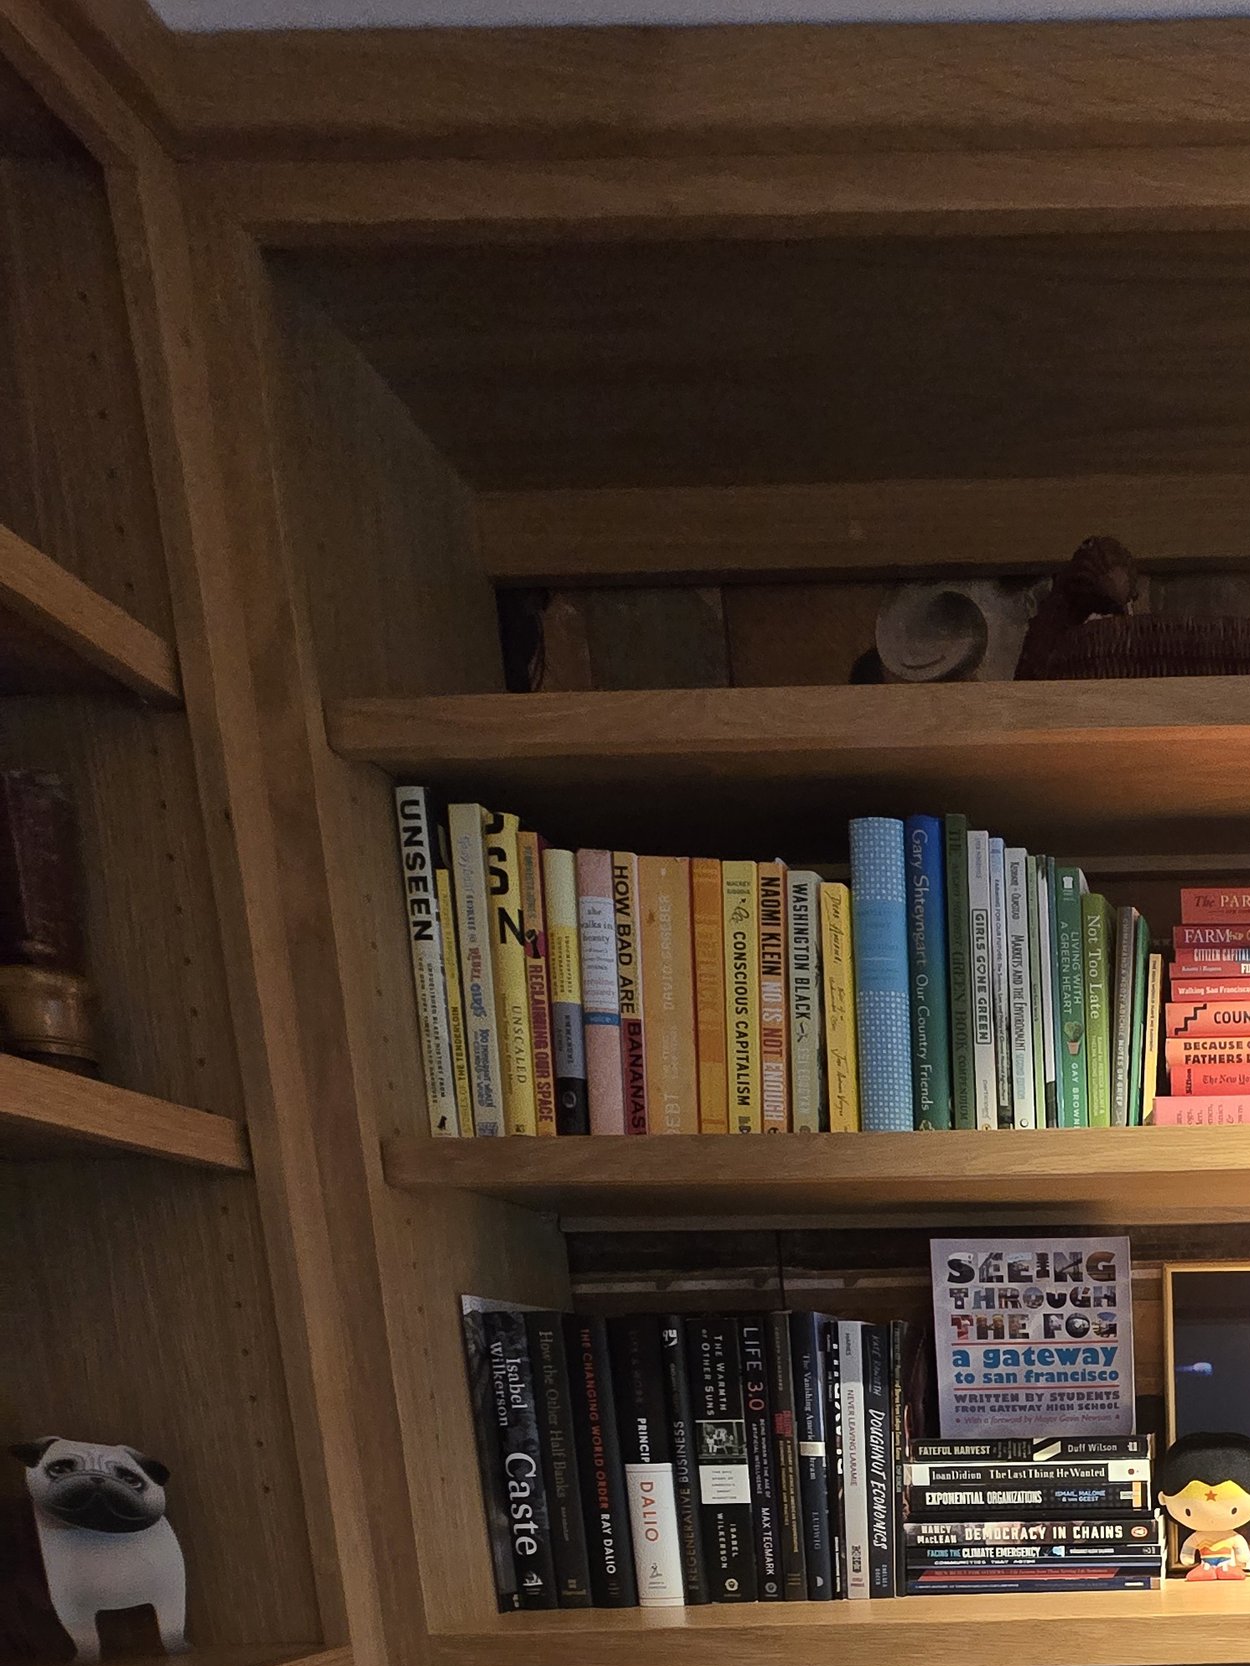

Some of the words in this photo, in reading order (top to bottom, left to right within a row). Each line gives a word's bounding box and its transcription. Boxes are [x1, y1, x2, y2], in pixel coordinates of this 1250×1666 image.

[911, 830, 930, 869] Gary
[400, 800, 434, 943] UNSEEN
[614, 866, 630, 917] HOW
[1194, 895, 1216, 907] The
[793, 883, 810, 972] WASHINGTON
[911, 875, 931, 967] Shteyngart
[1087, 915, 1101, 944] Not
[618, 924, 634, 966] BAD
[1069, 932, 1081, 971] LIVING
[732, 931, 749, 1016] CONSCIOUS
[1087, 948, 1102, 978] Too
[620, 975, 636, 1013] ARE
[794, 977, 811, 1021] BLACK
[916, 973, 930, 1002] Our
[1071, 974, 1082, 1005] WITH
[1089, 982, 1104, 1020] Late
[915, 1006, 932, 1060] Country
[1183, 1040, 1243, 1051] BECAUSE
[735, 1021, 752, 1107] CAPITALISM
[1184, 1054, 1243, 1065] FATHERS
[918, 1064, 934, 1112] Friends
[947, 1250, 1118, 1284] SEEING
[949, 1286, 1117, 1310] THROUGH
[950, 1313, 1030, 1341] THE
[1043, 1311, 1118, 1339] FOG
[713, 1334, 724, 1357] THE
[743, 1326, 763, 1372] LIFE
[952, 1348, 971, 1368] a
[982, 1345, 1119, 1369] gateway
[489, 1341, 510, 1427] Wilkerson
[505, 1357, 529, 1410] Isabel
[715, 1362, 728, 1411] WARMTH
[955, 1371, 976, 1385] to
[983, 1371, 1018, 1384] san
[1024, 1368, 1120, 1384] francisco
[747, 1380, 765, 1411] 3.0
[846, 1389, 855, 1416] NEVER
[953, 1393, 1020, 1404] WRITTEN
[1024, 1392, 1045, 1403] BY
[1049, 1390, 1121, 1402] STUDENTS
[954, 1404, 986, 1414] FROM
[989, 1403, 1043, 1413] GATEWAY
[1045, 1403, 1075, 1412] HIGH
[1077, 1402, 1121, 1411] SCHOOL
[847, 1416, 857, 1451] LEAVING
[868, 1408, 887, 1480] DOUGHNUT
[918, 1446, 953, 1456] FATEFUL
[953, 1445, 991, 1456] HARVEST
[1067, 1444, 1087, 1454] Duff
[1088, 1443, 1118, 1453] Wilson
[849, 1452, 859, 1487] LARAMIE
[504, 1452, 541, 1556] Caste
[639, 1480, 659, 1543] DALIO
[871, 1480, 889, 1551] ECONOMICS
[925, 1490, 985, 1506] EXPONENTIAL
[986, 1490, 1044, 1505] ORGANIZATIONS
[760, 1506, 774, 1529] MAX
[921, 1525, 952, 1535] NANCY
[964, 1526, 1048, 1541] DEMOCRACY
[1051, 1525, 1068, 1540] IN
[1072, 1525, 1124, 1540] CHAINS
[763, 1530, 776, 1576] TEGMARK
